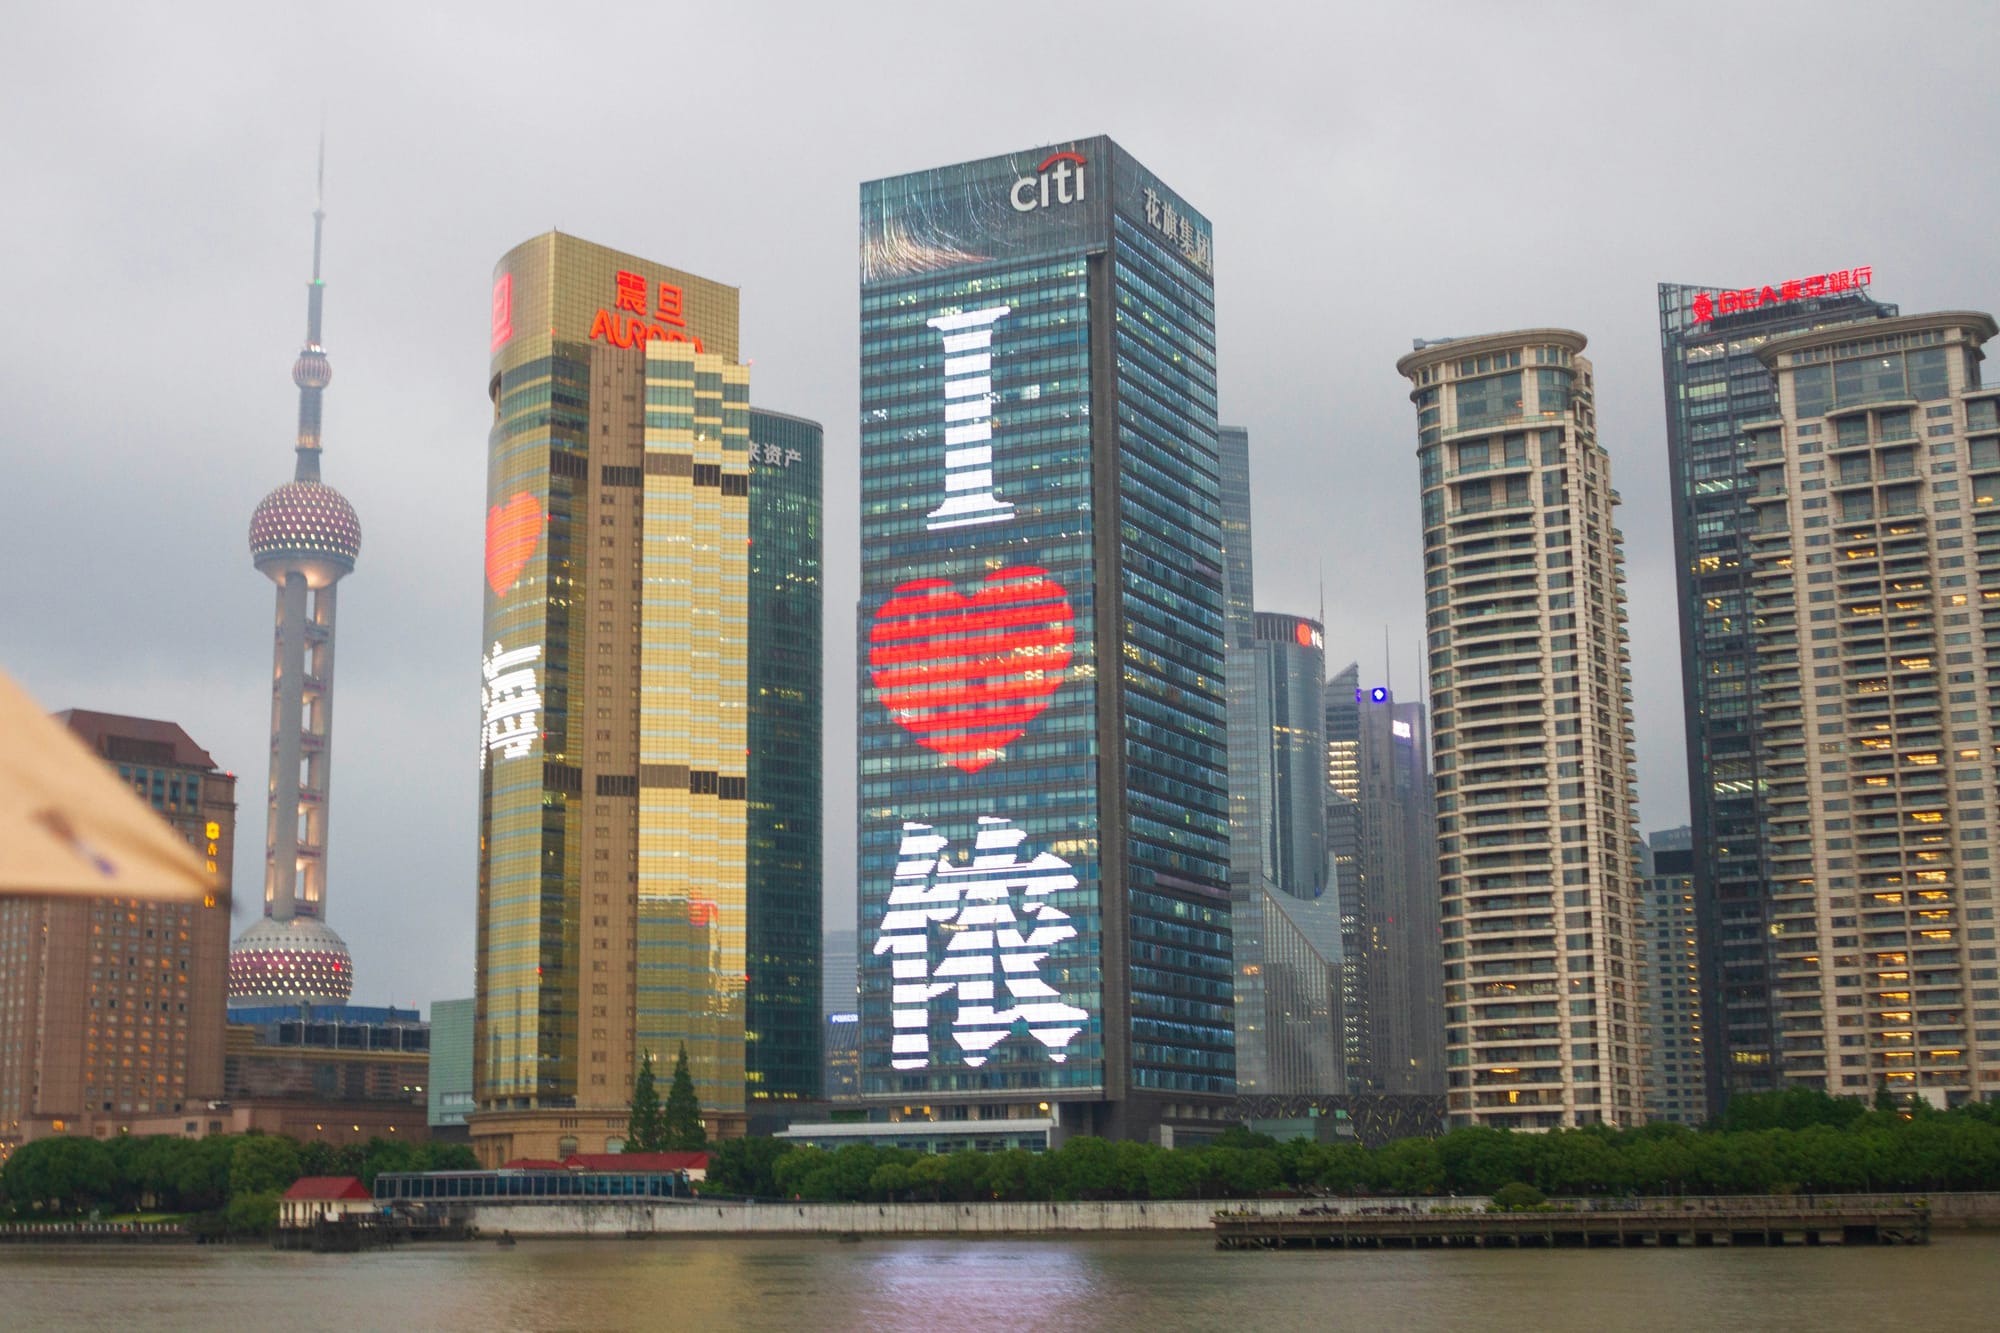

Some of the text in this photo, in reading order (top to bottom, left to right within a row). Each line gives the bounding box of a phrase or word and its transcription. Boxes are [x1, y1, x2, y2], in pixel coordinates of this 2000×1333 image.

[1010, 160, 1084, 212] citi
[1144, 187, 1211, 271] 花旗集团
[616, 270, 686, 327] 震旦
[1718, 286, 1779, 313] BEA
[926, 306, 1015, 530] I
